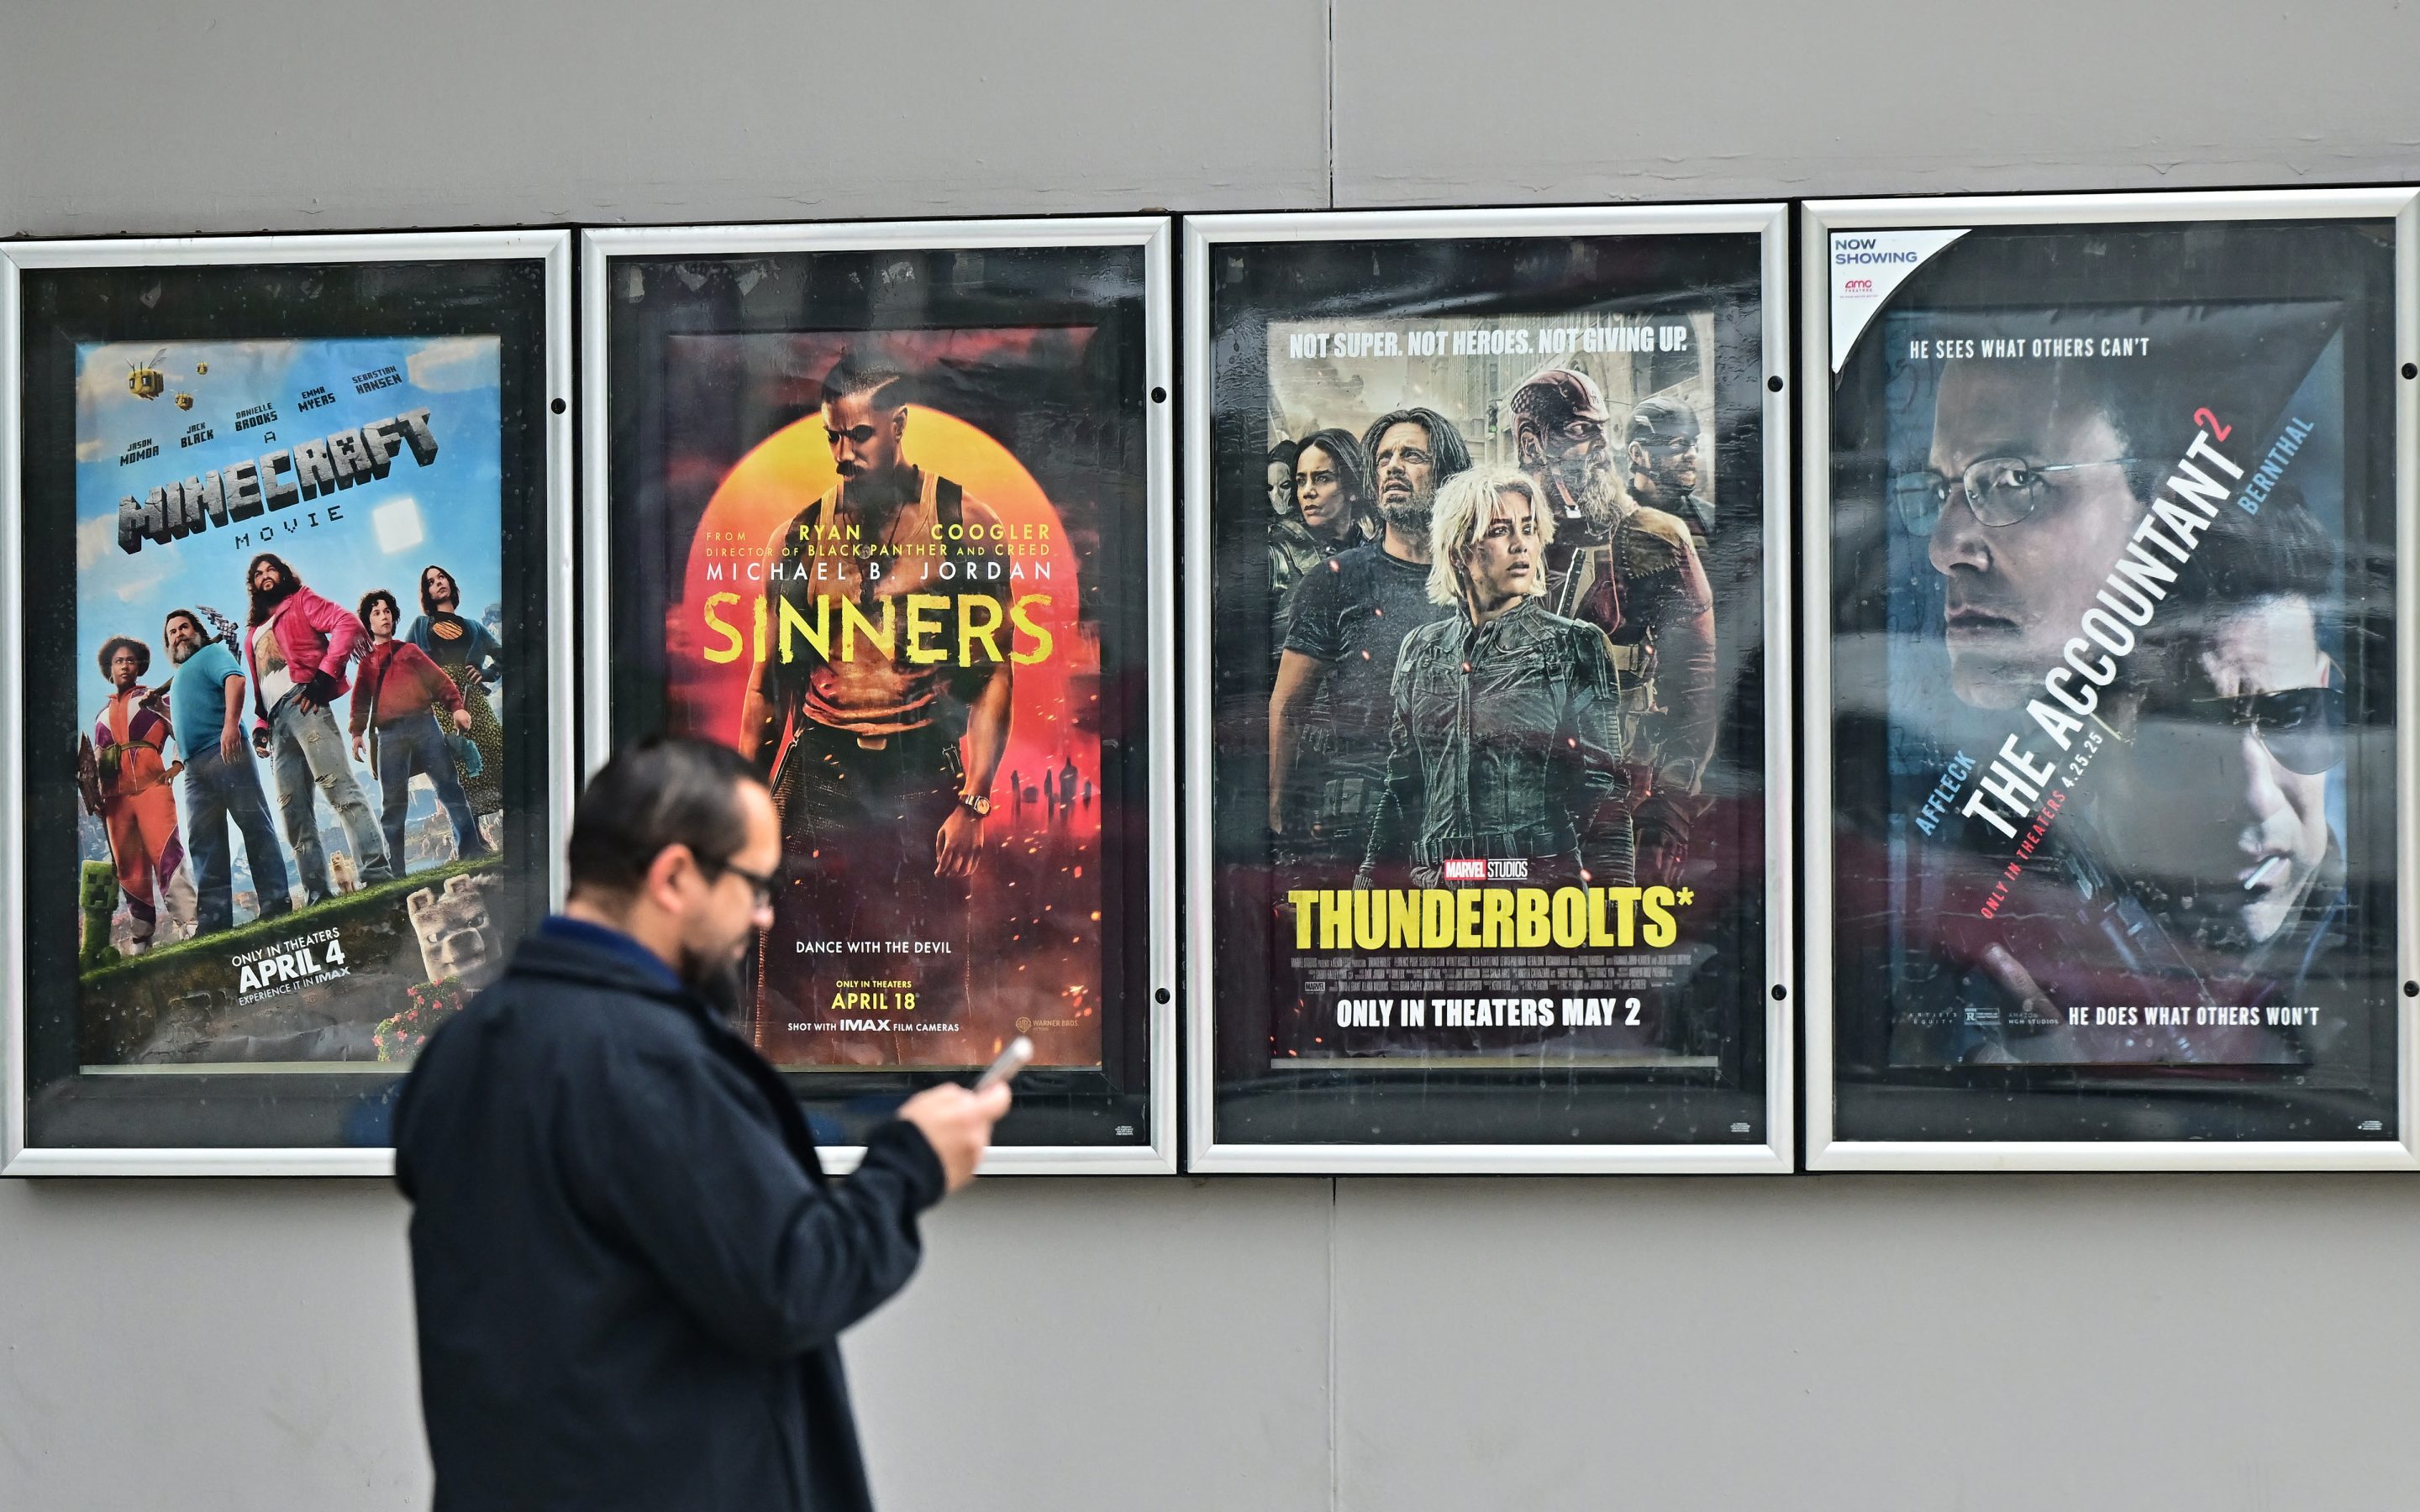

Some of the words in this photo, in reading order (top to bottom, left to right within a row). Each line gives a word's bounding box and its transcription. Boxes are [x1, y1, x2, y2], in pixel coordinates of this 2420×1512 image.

[1835, 239, 1876, 250] NOW
[1834, 252, 1918, 265] SHOWING
[1290, 333, 1328, 359] NOT
[1334, 331, 1402, 358] SUPER.
[1408, 330, 1446, 356] NOT
[1453, 329, 1534, 355] HEROES.
[1539, 328, 1577, 354] NOT
[1583, 327, 1654, 353] GIVING
[1659, 326, 1687, 352] UP.
[1910, 340, 1929, 359] HE
[1936, 339, 1975, 359] SEES
[1981, 339, 2026, 358] WHAT
[2033, 338, 2094, 357] OTHERS
[2101, 337, 2149, 357] CAN'T
[352, 365, 397, 385] SEBASTIAN
[355, 372, 402, 395] HANSEN
[298, 393, 336, 412] MYERS
[301, 386, 325, 400] EMMA
[235, 402, 273, 419] DANIELLE
[186, 421, 206, 435] JACK
[234, 411, 278, 432] BROOKS
[127, 438, 152, 452] JASON
[181, 429, 213, 449] BLACK
[264, 432, 276, 444] A
[119, 445, 160, 466] MOMOA
[2237, 416, 2314, 515] BERNTHAL
[118, 407, 439, 554] MINECRAFT
[235, 506, 343, 549] MOVIE
[706, 532, 745, 541] FROM
[799, 524, 860, 540] RYAN
[931, 523, 1050, 540] COOGLER
[706, 547, 773, 557] DIRECTOR
[781, 547, 799, 556] OF
[808, 544, 862, 557] BLACK
[870, 544, 947, 556] PANTHER
[957, 547, 985, 556] AND
[995, 543, 1050, 556] CREED
[707, 562, 846, 580] MICHAEL
[870, 563, 897, 580] B.
[920, 562, 1051, 580] JORDAN
[704, 591, 1053, 667] SINNERS
[1962, 733, 2055, 839] THE
[2026, 430, 2244, 751] ACCOUNTANT
[1915, 750, 1976, 837] AFFLECK
[1981, 881, 2008, 919] ONLY
[2004, 862, 2022, 880] IN
[2017, 790, 2065, 860] THEATERS
[2061, 732, 2104, 788] 4.25.25
[1447, 861, 1486, 878] MARVEL
[1487, 860, 1528, 878] STUDIOS
[232, 948, 263, 967] ONLY
[266, 944, 281, 958] IN
[284, 927, 340, 953] THEATERS
[796, 942, 843, 953] DANCE
[847, 941, 881, 953] WITH
[886, 942, 909, 953] THE
[914, 942, 951, 953] DEVIL
[239, 948, 321, 994] APRIL
[325, 939, 345, 965] 4
[239, 984, 291, 1006] EXPERIENCE
[293, 980, 301, 991] IT
[302, 977, 313, 988] IN
[315, 967, 351, 984] IMAX
[836, 980, 859, 989] ONLY
[1305, 982, 1325, 991] MARVEL
[831, 993, 888, 1010] APRIL
[894, 993, 916, 1010] 18
[1336, 999, 1391, 1028] ONLY
[1402, 999, 1425, 1027] IN
[1432, 998, 1555, 1027] THEATERS
[1562, 997, 1618, 1026] MAY
[1624, 997, 1640, 1026] 2
[1965, 1012, 1975, 1021] R
[2069, 1006, 2089, 1026] HE
[2096, 1006, 2138, 1026] DOES
[2144, 1006, 2191, 1026] WHAT
[2196, 1006, 2260, 1026] OTHERS
[2266, 1006, 2320, 1026] WON'T
[787, 1023, 813, 1032] SHOT
[814, 1023, 837, 1032] WITH
[839, 1019, 891, 1032] IMAX
[893, 1023, 913, 1032] FILM
[916, 1023, 960, 1032] CAMERAS
